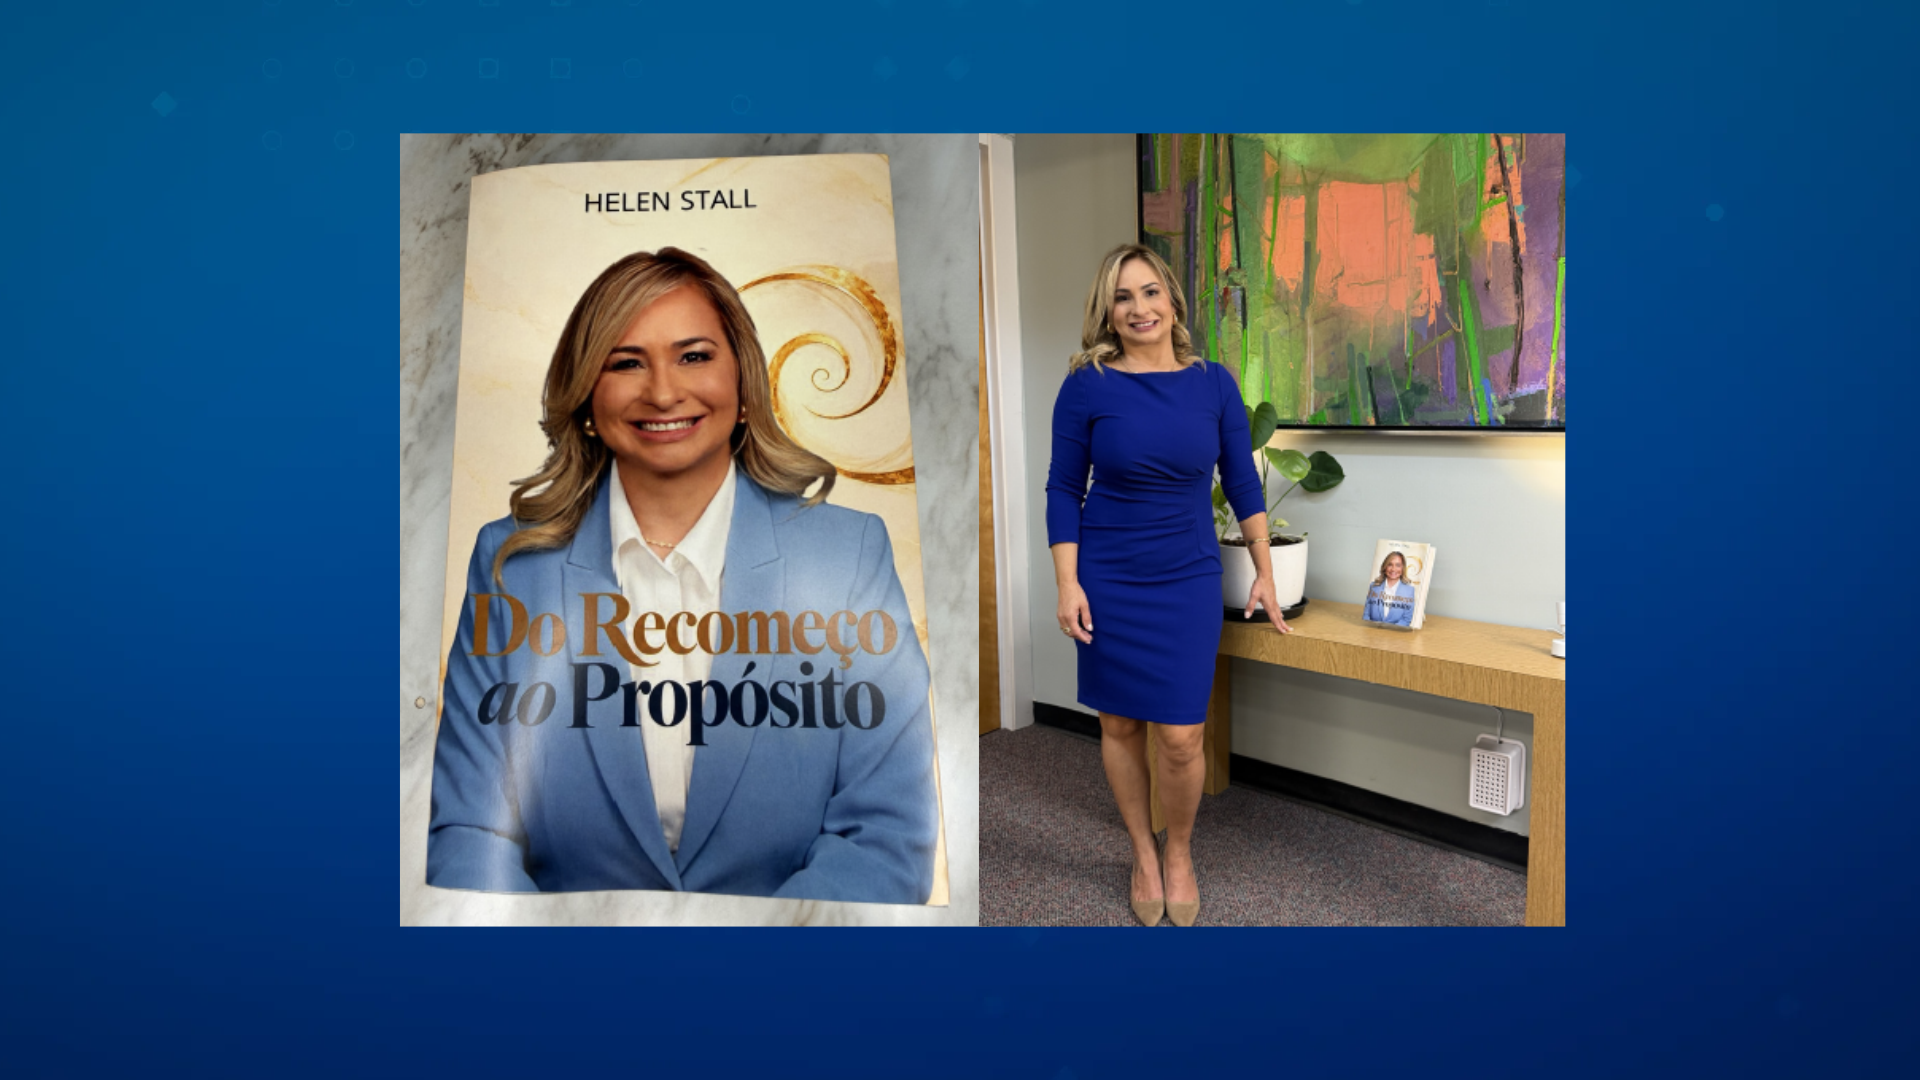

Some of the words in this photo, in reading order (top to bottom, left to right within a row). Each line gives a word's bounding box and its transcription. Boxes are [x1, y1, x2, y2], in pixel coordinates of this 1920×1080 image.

[584, 191, 670, 213] HELEN
[680, 188, 757, 211] STALL
[467, 592, 566, 657] Do
[576, 592, 898, 670] Recomeço
[477, 680, 557, 727] ao
[566, 660, 886, 746] Propósito
